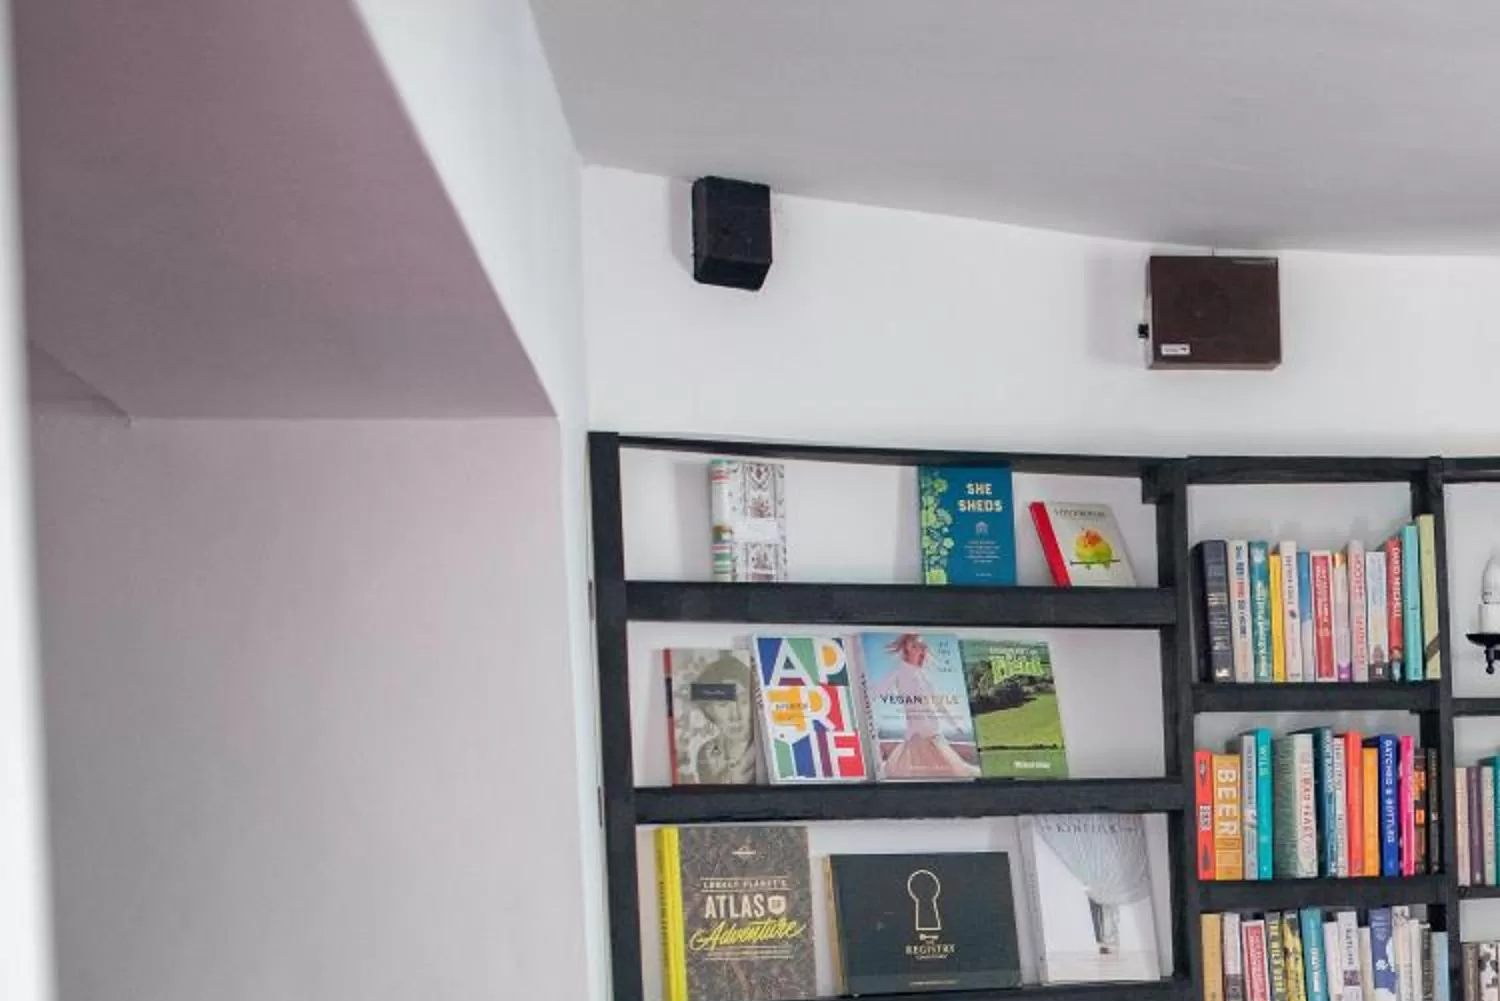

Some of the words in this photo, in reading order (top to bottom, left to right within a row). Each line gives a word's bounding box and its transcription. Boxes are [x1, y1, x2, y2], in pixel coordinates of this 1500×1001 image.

[966, 483, 993, 495] SHE
[958, 500, 1003, 512] SHEDS
[1217, 769, 1237, 837] BEER
[704, 893, 765, 919] ATLAS
[688, 915, 806, 951] Adventure
